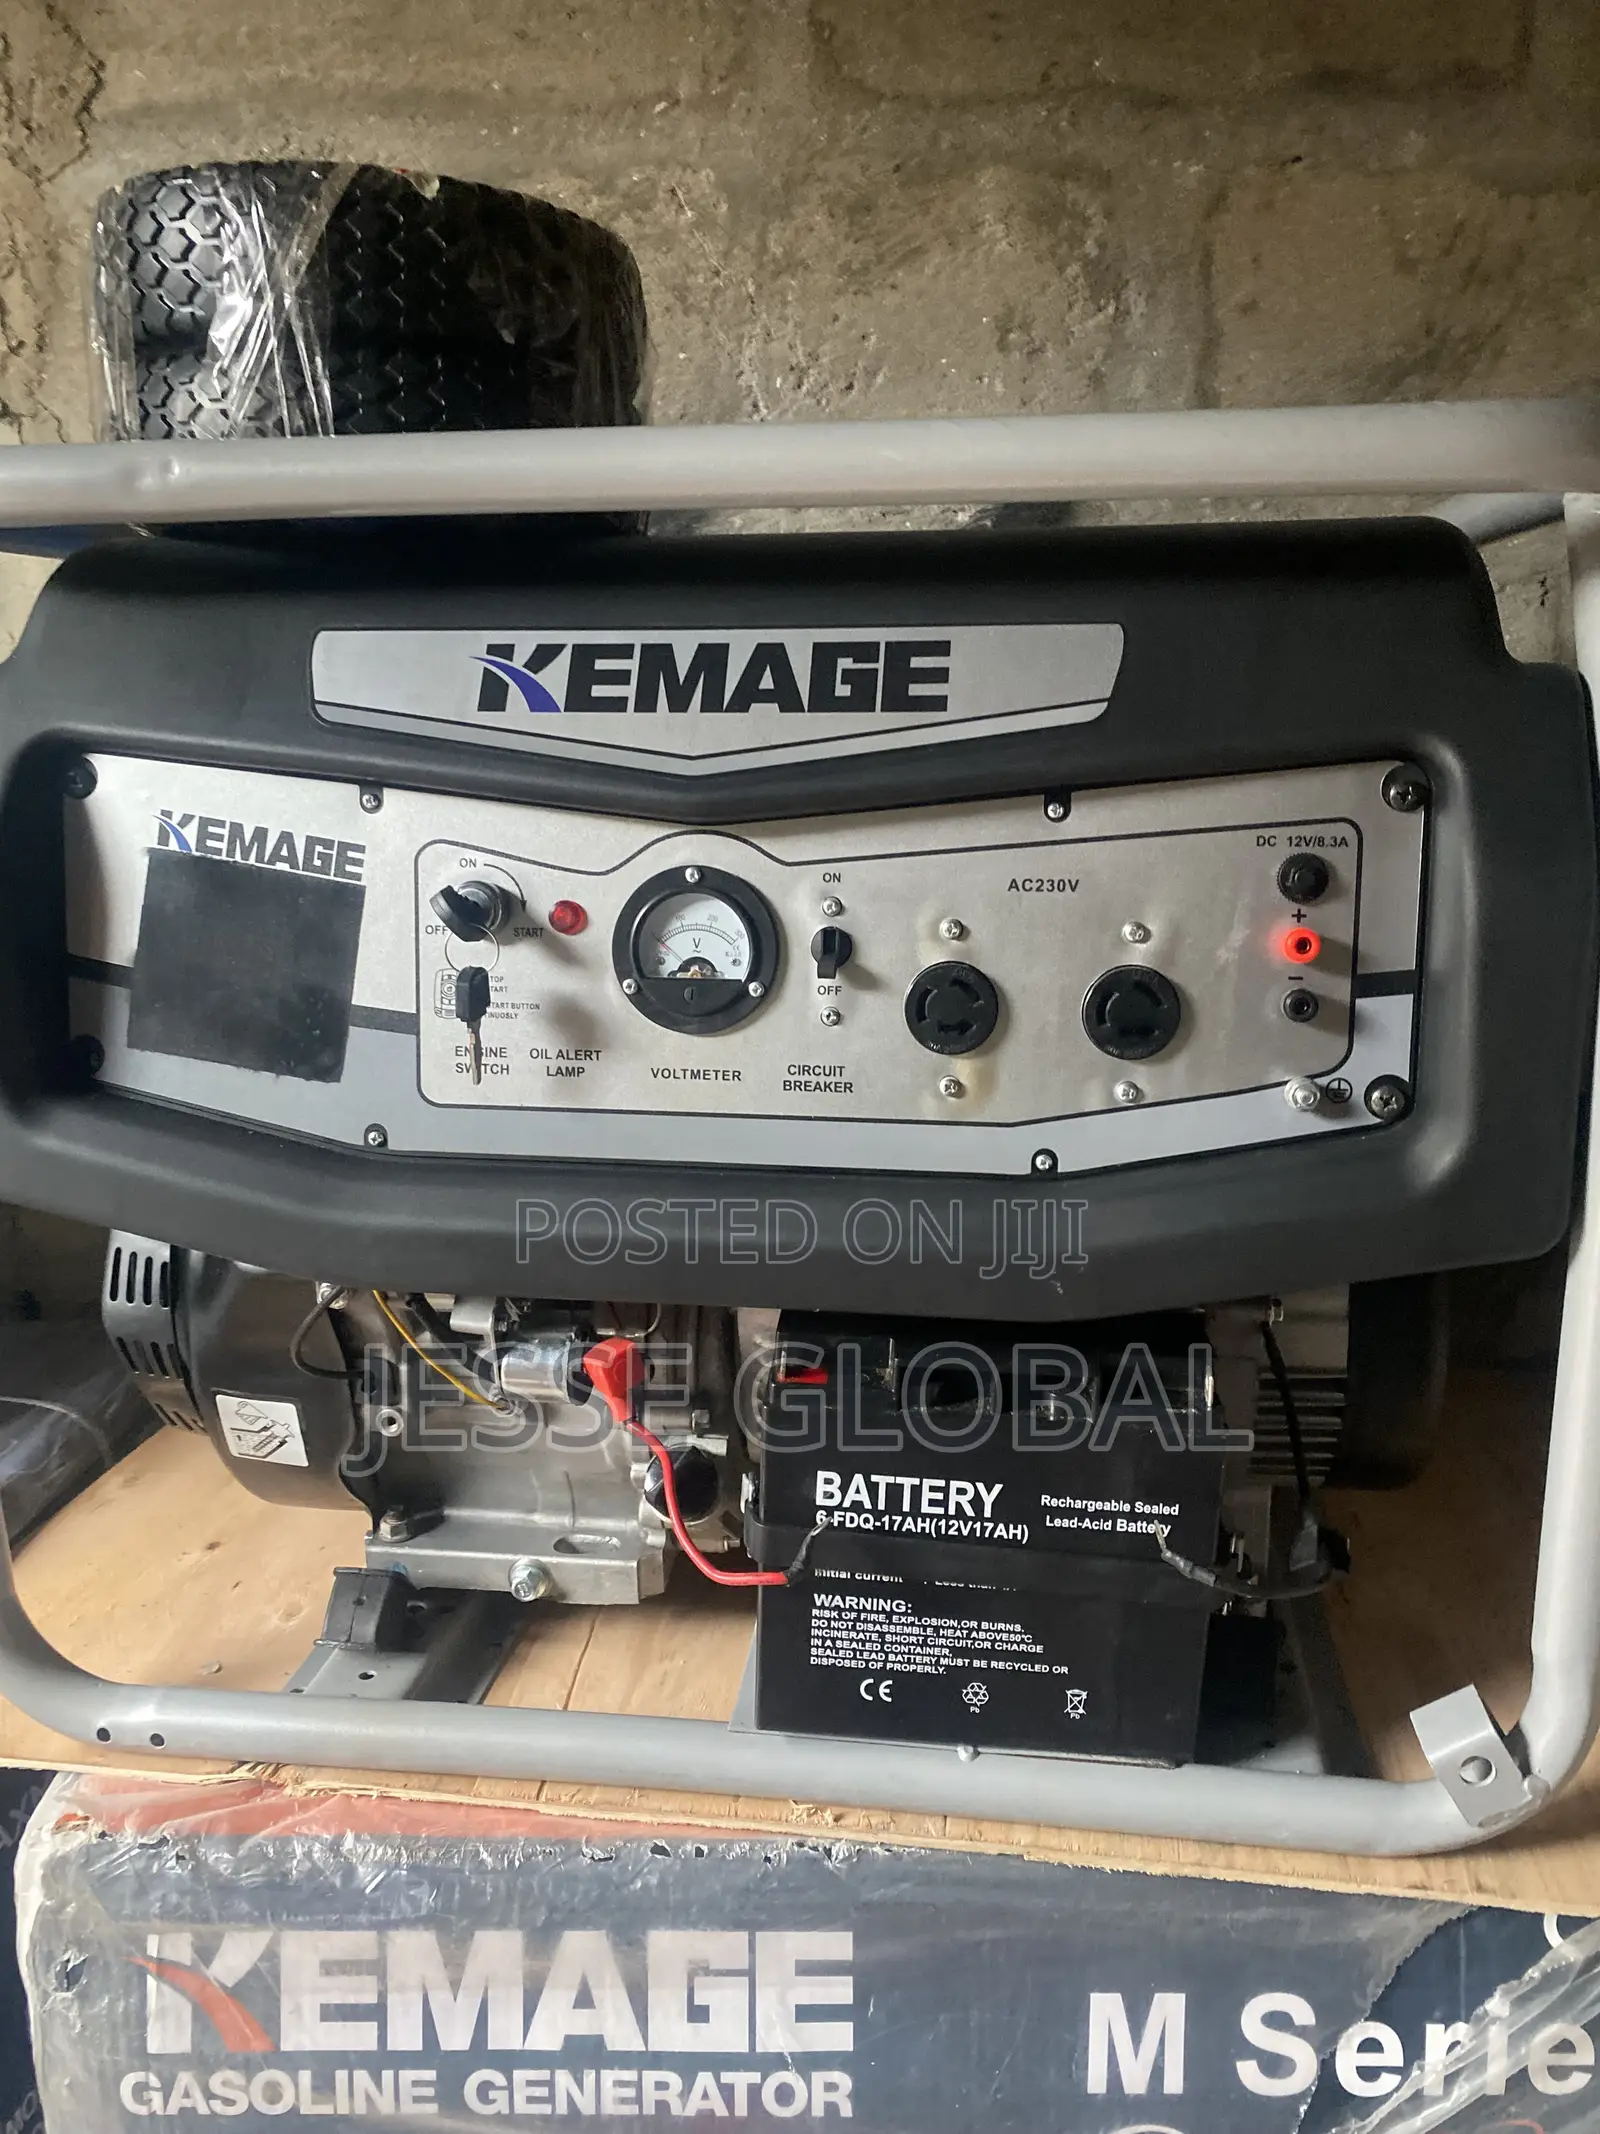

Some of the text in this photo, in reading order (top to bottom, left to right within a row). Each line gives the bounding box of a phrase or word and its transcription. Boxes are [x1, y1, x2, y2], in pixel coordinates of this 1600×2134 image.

[468, 640, 951, 713] KEMAGE
[152, 809, 366, 882] KEMAGE
[1256, 835, 1349, 848] DC 12V/8.3A
[459, 858, 477, 868] ON
[822, 872, 841, 883] ON
[1008, 878, 1080, 893] AC230V
[425, 924, 448, 935] OFF
[513, 927, 544, 938] START
[693, 937, 701, 949] V
[489, 985, 508, 994] TART
[817, 985, 842, 996] OFF
[530, 1048, 602, 1061] OIL ALERT
[455, 1063, 510, 1075] SWTCH
[546, 1065, 585, 1078] LAMP
[651, 1067, 742, 1081] VOLTMETER
[787, 1064, 845, 1077] CIRCUIT
[783, 1080, 854, 1093] BREAKER
[815, 1470, 1004, 1518] BATTERY
[1041, 1494, 1180, 1516] Rechargeable Sealed
[1046, 1515, 1112, 1531] Lead-Acid
[813, 1593, 912, 1613] WARNING:
[811, 1609, 1025, 1632] RISK OF FIRE, EXPLOSION,OR BURNS.
[811, 1619, 828, 1628] DO
[830, 1621, 854, 1630] NOT
[856, 1622, 937, 1637] DISASSEMBLE,
[940, 1629, 968, 1638] HEAT
[810, 1638, 953, 1657] IN A SEALED CONTAINER,
[811, 1628, 1044, 1653] INCINERATE, SHORT CIRCUIT,OR CHARGE
[810, 1648, 1069, 1675] SEALED LEAD BATTERY MUST BE RECYCLED OR
[810, 1657, 947, 1675] DISPOSED OF PROPERLY.
[859, 1678, 893, 1702] CE
[970, 1706, 980, 1714] Pb
[1070, 1712, 1081, 1720] Pb
[121, 1930, 853, 2053] KEMAGE
[1086, 1992, 1186, 2094] M
[119, 2068, 853, 2118] GASOLINE GENERATOR
